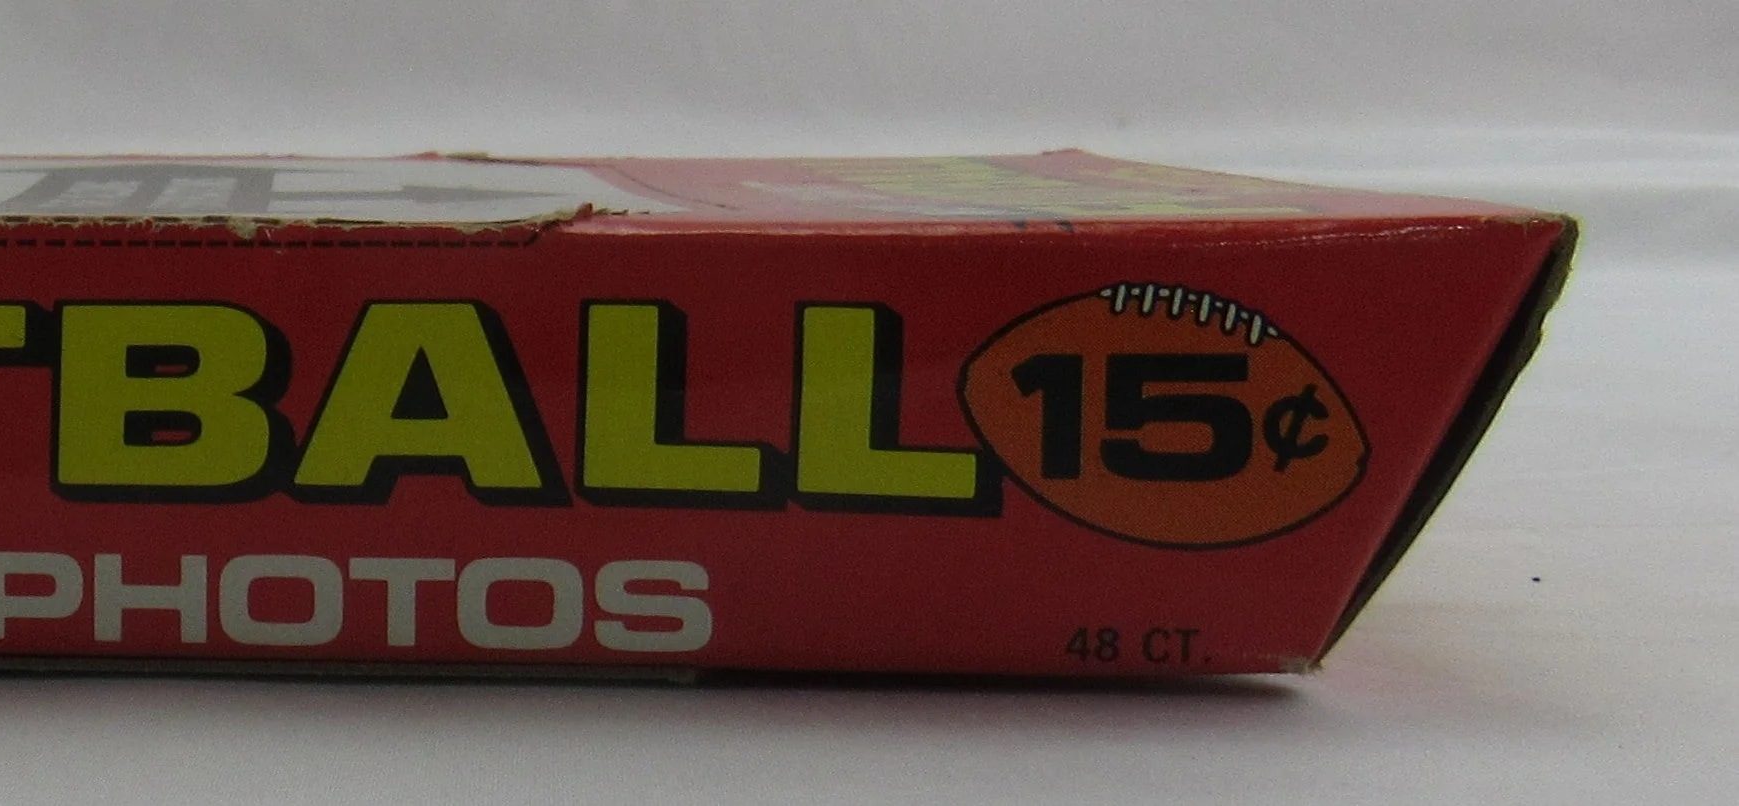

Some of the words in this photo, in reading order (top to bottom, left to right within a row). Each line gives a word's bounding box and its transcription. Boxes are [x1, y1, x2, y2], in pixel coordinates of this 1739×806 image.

[1011, 353, 1328, 482] 15¢
[1065, 627, 1120, 663] 48
[1141, 627, 1212, 664] CT.
